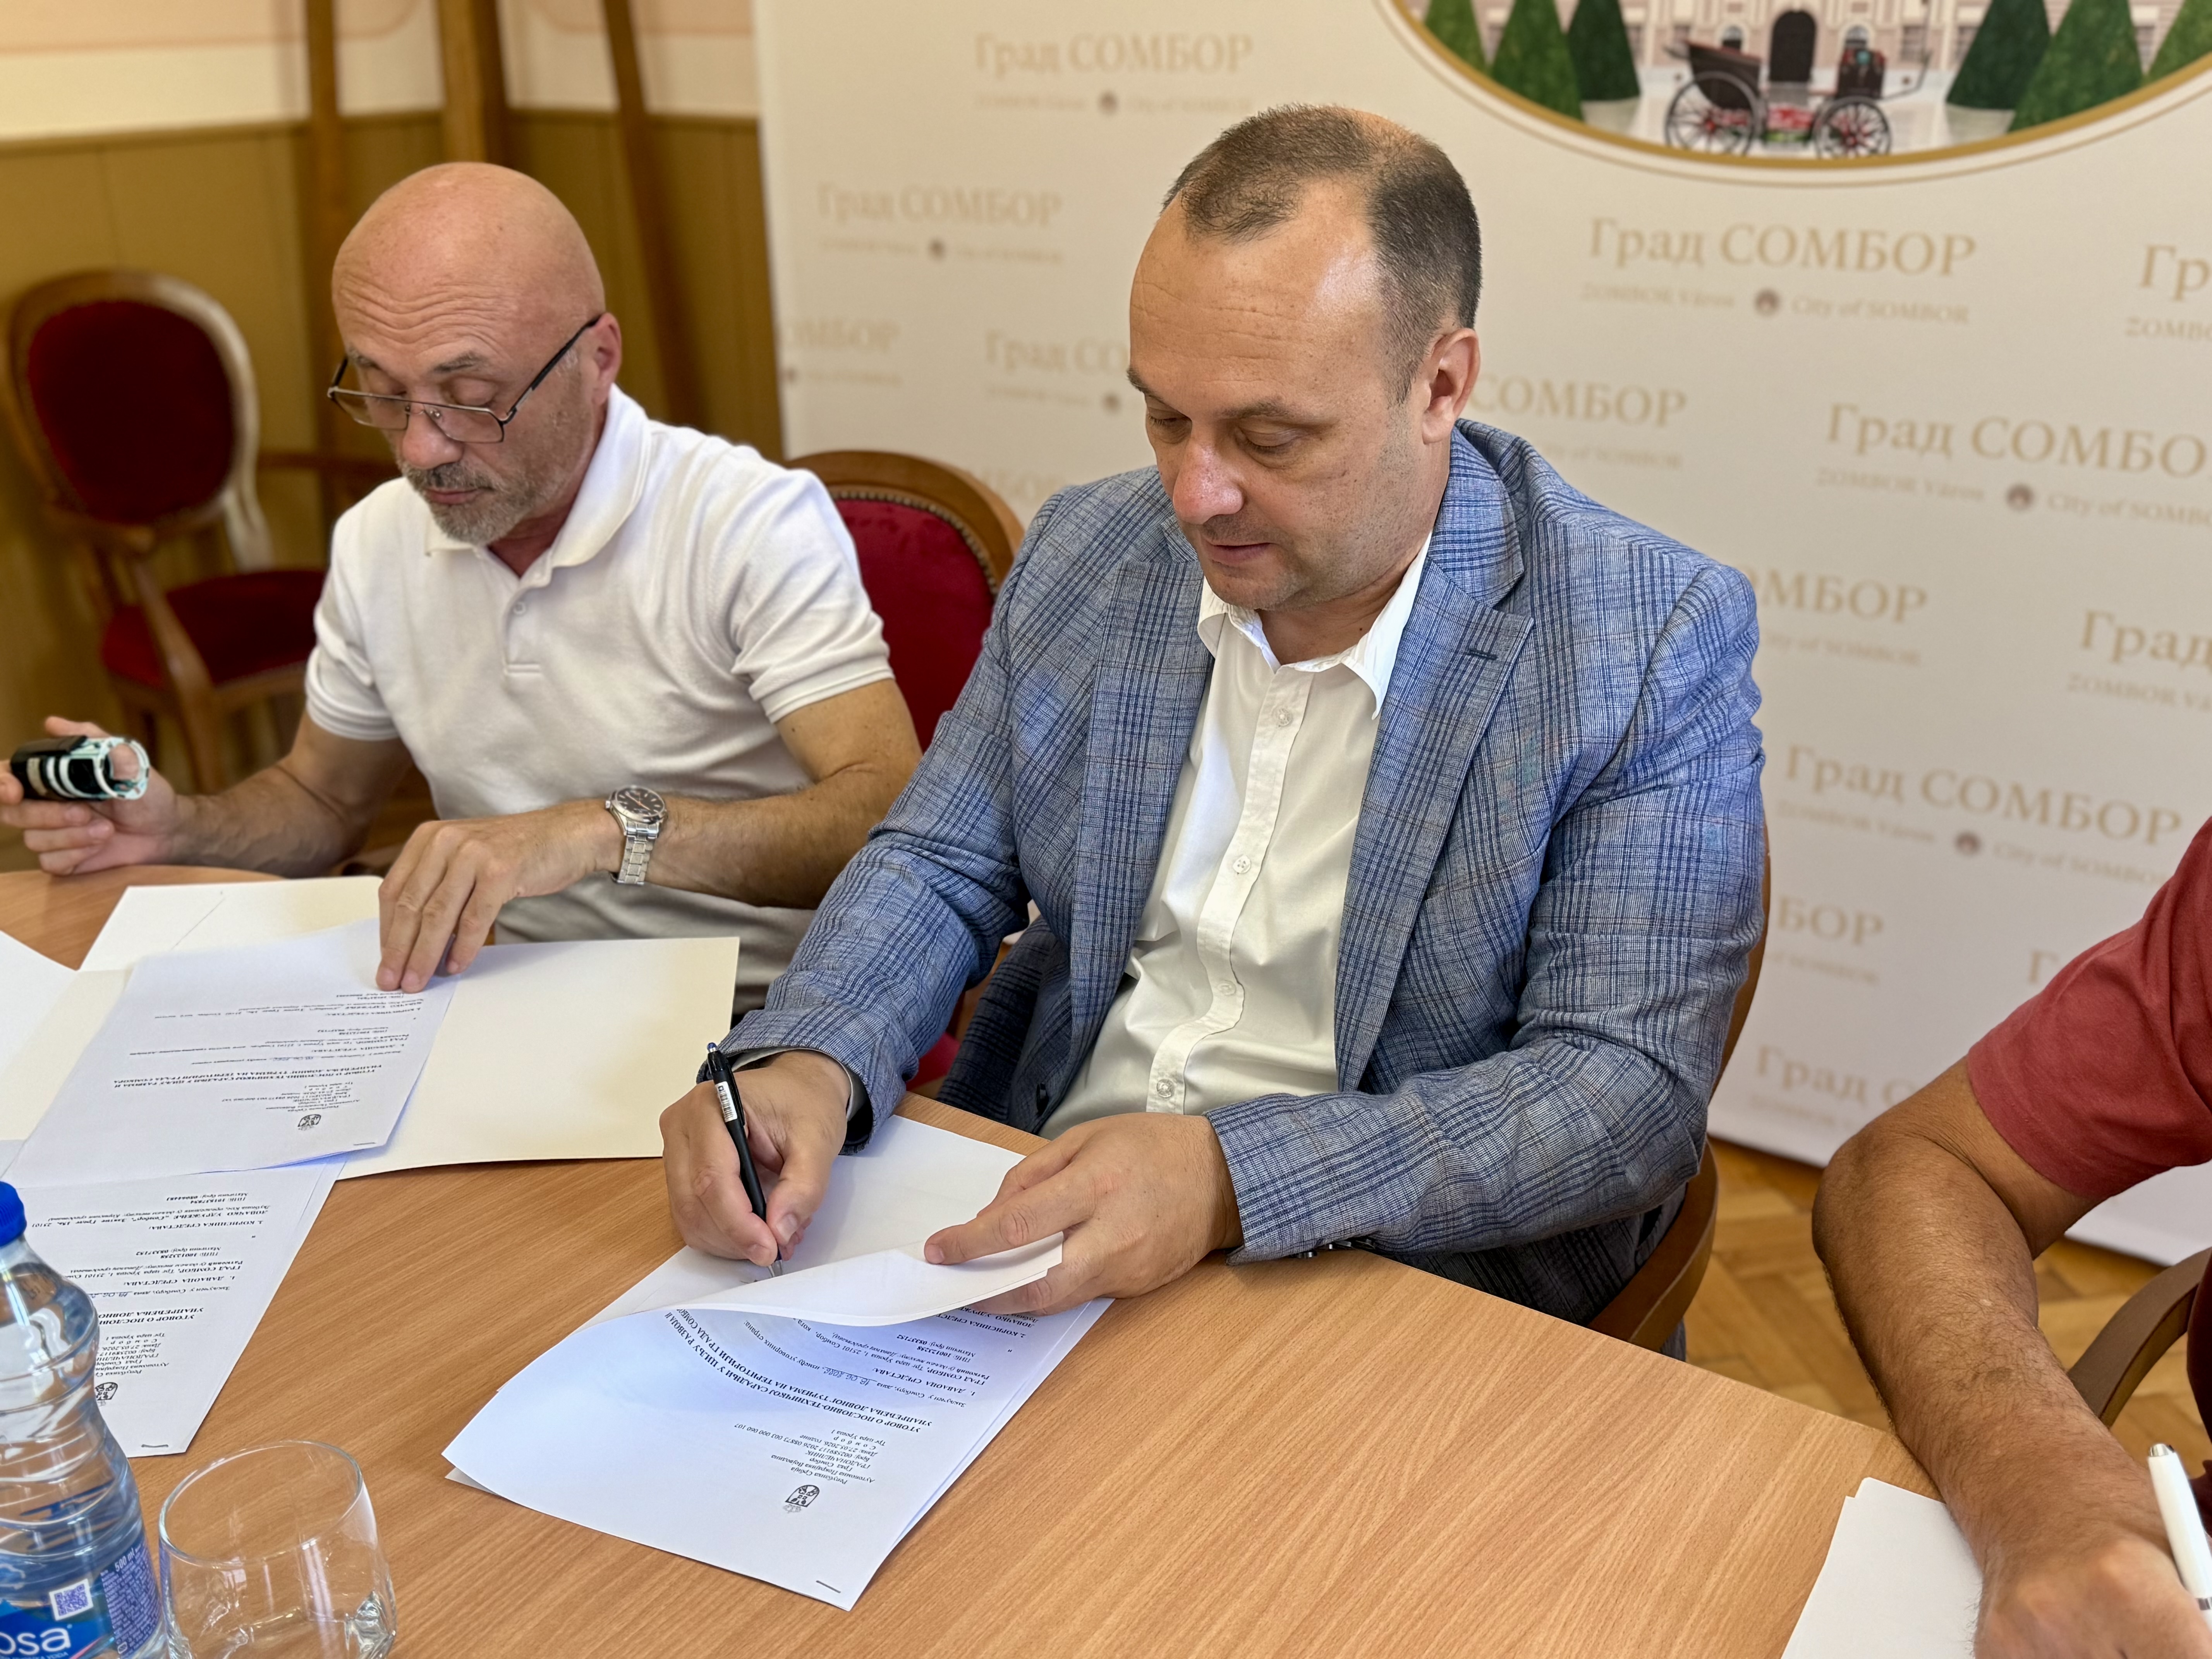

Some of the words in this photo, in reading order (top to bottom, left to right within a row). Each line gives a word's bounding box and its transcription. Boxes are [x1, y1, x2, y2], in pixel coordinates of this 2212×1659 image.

[975, 33, 1059, 80] Град
[1069, 33, 1254, 74] СОМБОР
[1589, 216, 1705, 268] Град
[1720, 223, 1977, 276] СОМБОР
[1827, 401, 1954, 460] Град
[1785, 742, 1906, 805] Град
[1920, 767, 2183, 846] СОМБОР
[1755, 1043, 1868, 1104] Град
[668, 1314, 694, 1345] РАЗВОЈА
[697, 1328, 720, 1352] ГРАДА
[816, 1332, 840, 1348] Сомбор,
[693, 1345, 718, 1367] ЦИЉУ
[719, 1350, 772, 1384] ТЕРИТОРИЈИ
[726, 1370, 768, 1392] САРАДЊИ
[873, 1369, 922, 1383] СРЕДСТАВА:
[927, 1367, 962, 1379] СОМБОР,
[790, 1386, 828, 1401] ТУРИЗМА
[926, 1381, 966, 1393] ДАВАОЦА
[769, 1390, 875, 1422] ПОСЛОВНО-ТЕХНИЧКОЈ
[830, 1398, 869, 1411] ЛОВНОГ
[871, 1408, 932, 1426] УНАПРЕЂЕЊА
[884, 1421, 920, 1432] УГОВОР
[810, 1458, 834, 1467] Сомбор
